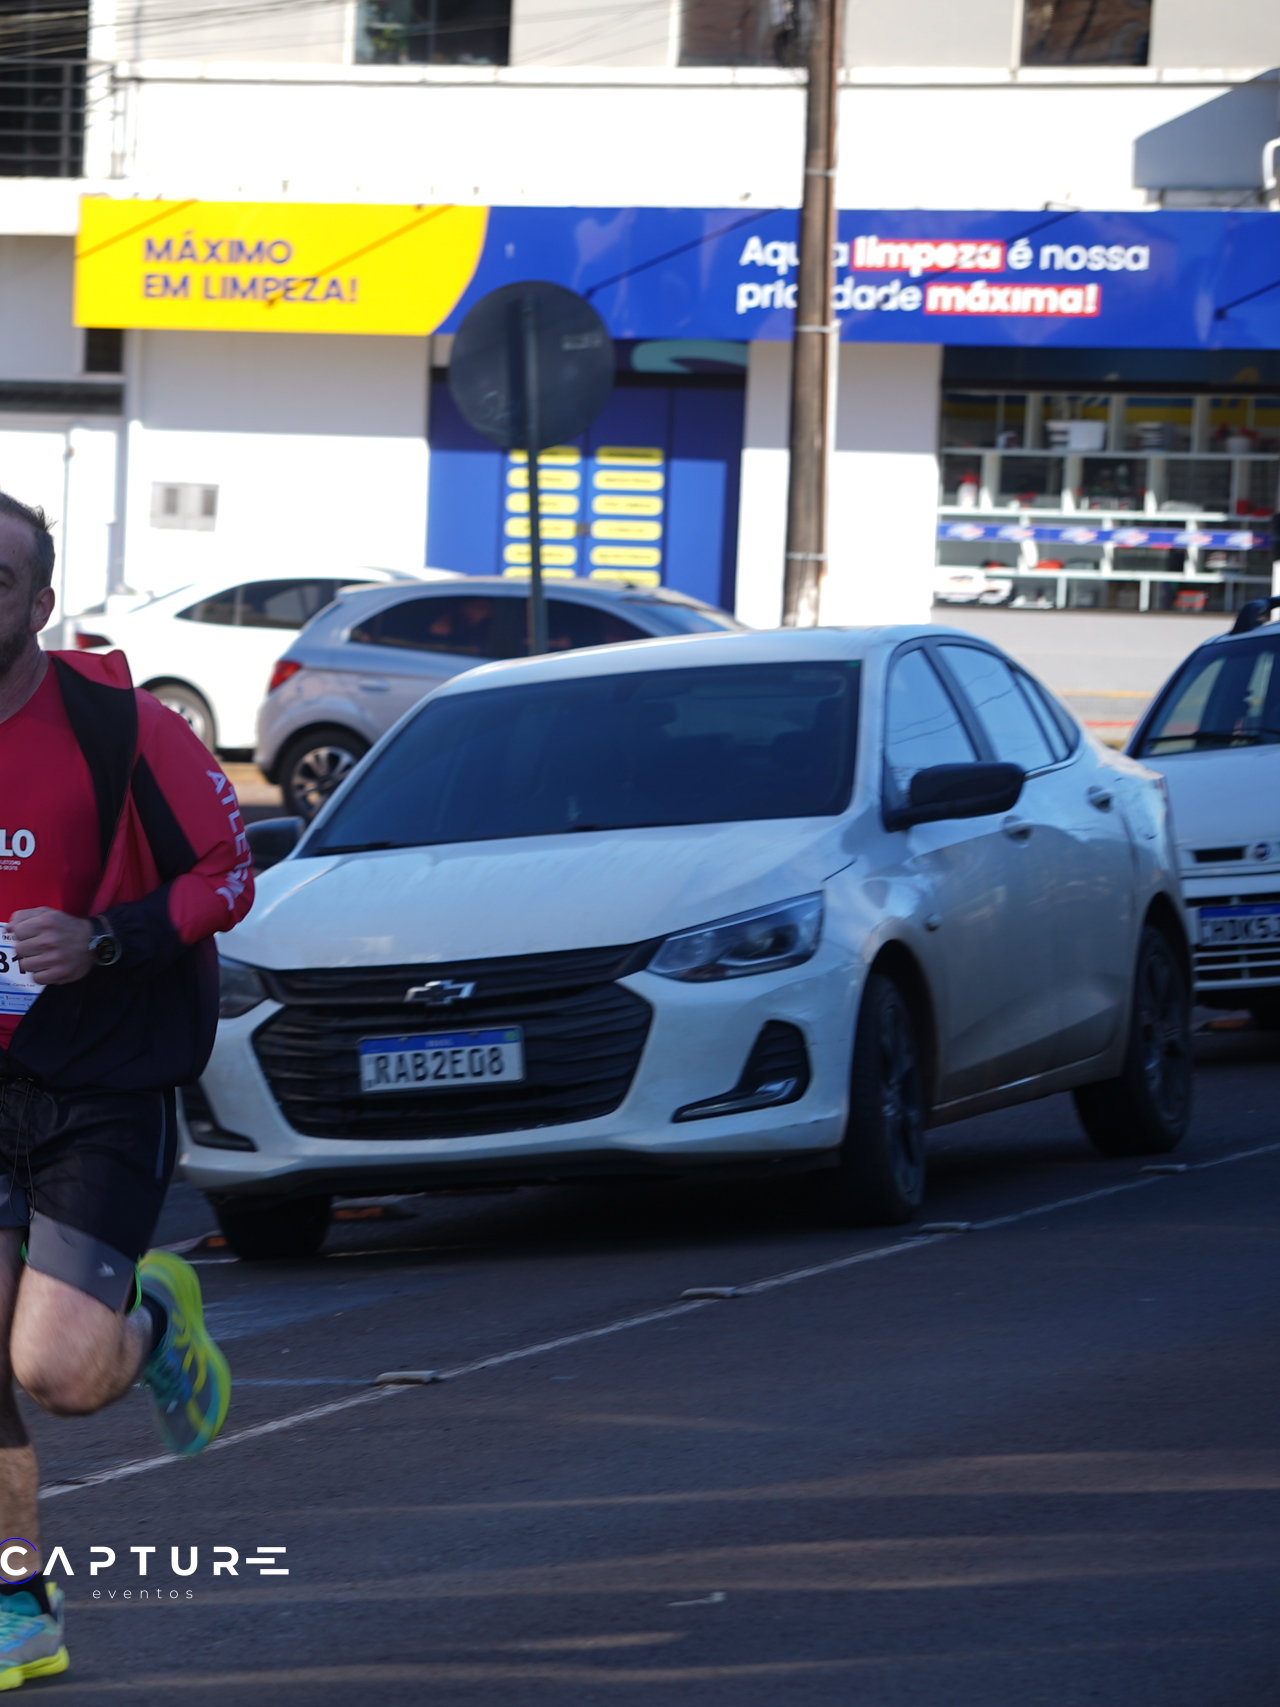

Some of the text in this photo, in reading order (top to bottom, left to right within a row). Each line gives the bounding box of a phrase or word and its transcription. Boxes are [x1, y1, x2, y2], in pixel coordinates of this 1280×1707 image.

[144, 230, 292, 264] MÁXIMO
[739, 235, 800, 276] Aqu
[854, 235, 1002, 277] limpeza
[1007, 237, 1033, 270] é
[1039, 244, 1150, 271] nossa
[144, 274, 357, 303] EM LIMPEZA!
[736, 276, 1099, 315] priodade máxima!
